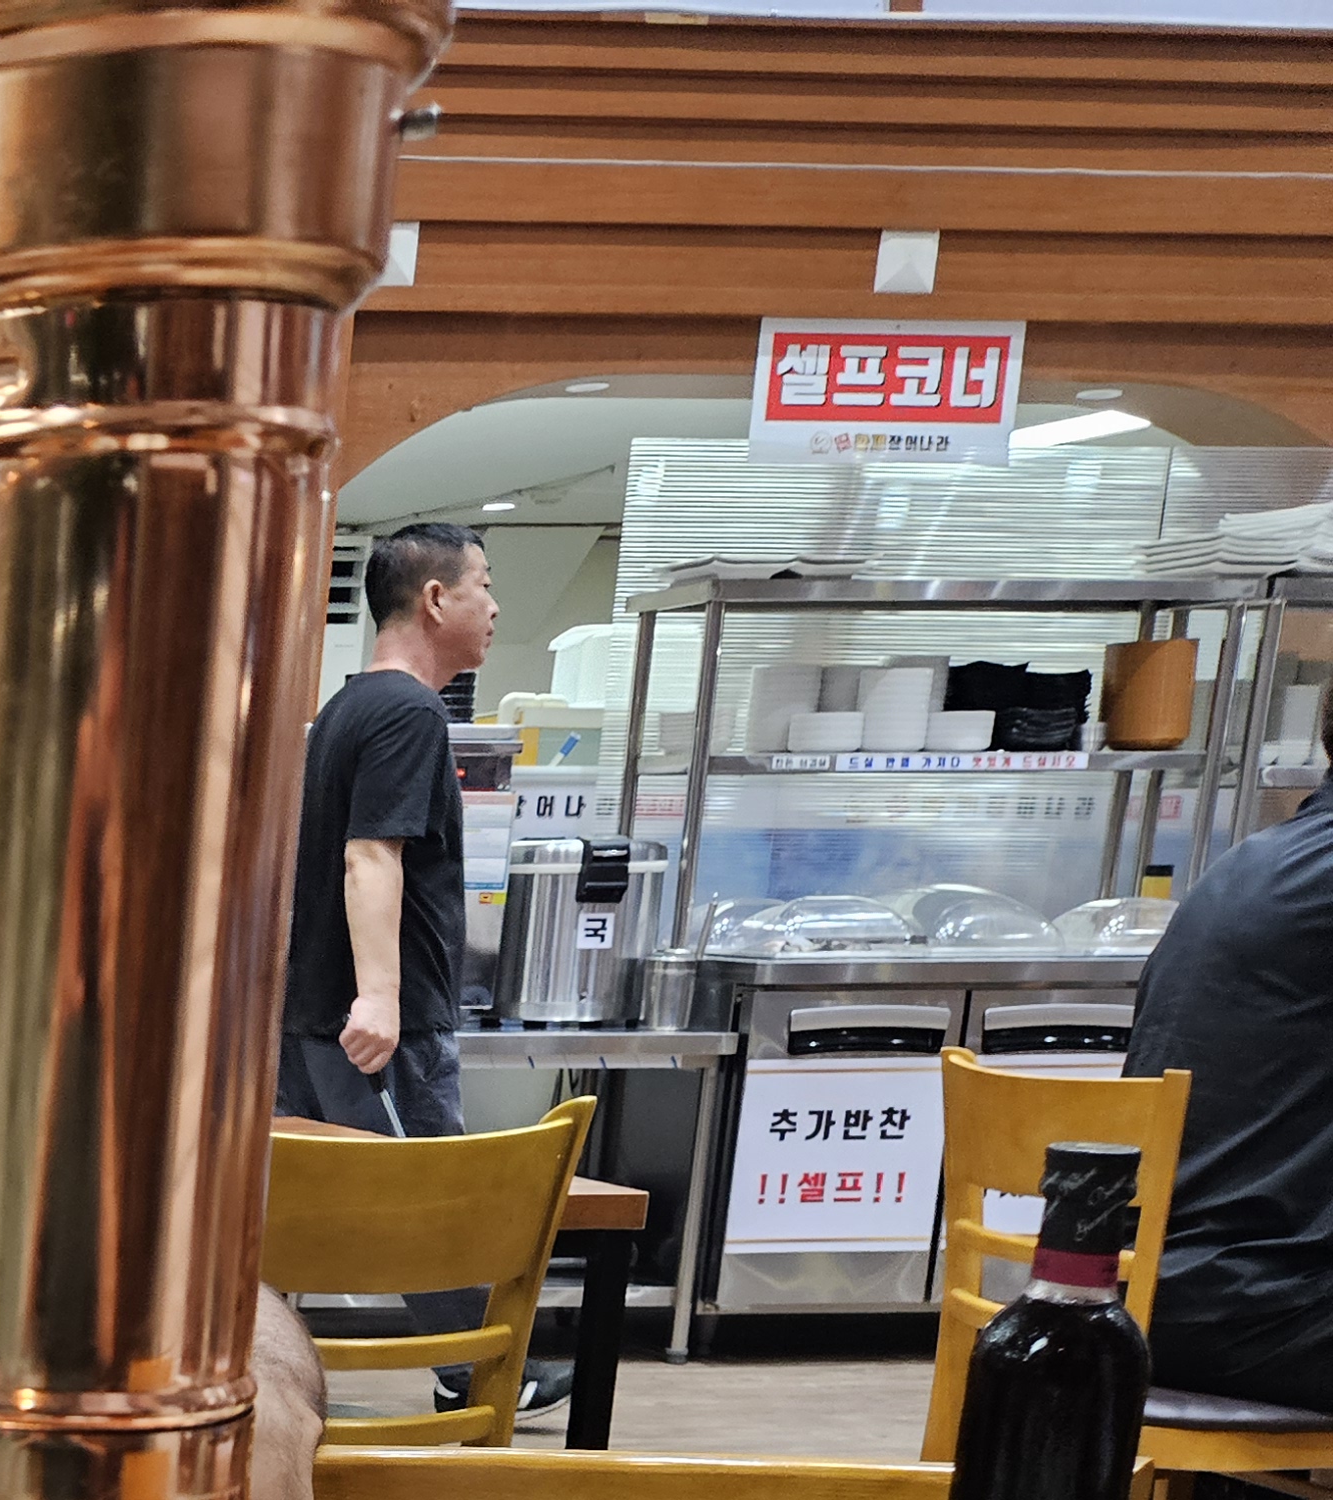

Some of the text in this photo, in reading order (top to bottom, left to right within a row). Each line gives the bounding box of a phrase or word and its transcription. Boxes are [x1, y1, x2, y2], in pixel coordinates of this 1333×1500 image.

[776, 344, 1001, 408] 셀프코너
[584, 918, 607, 943] 국
[769, 1107, 911, 1141] 추가반찬
